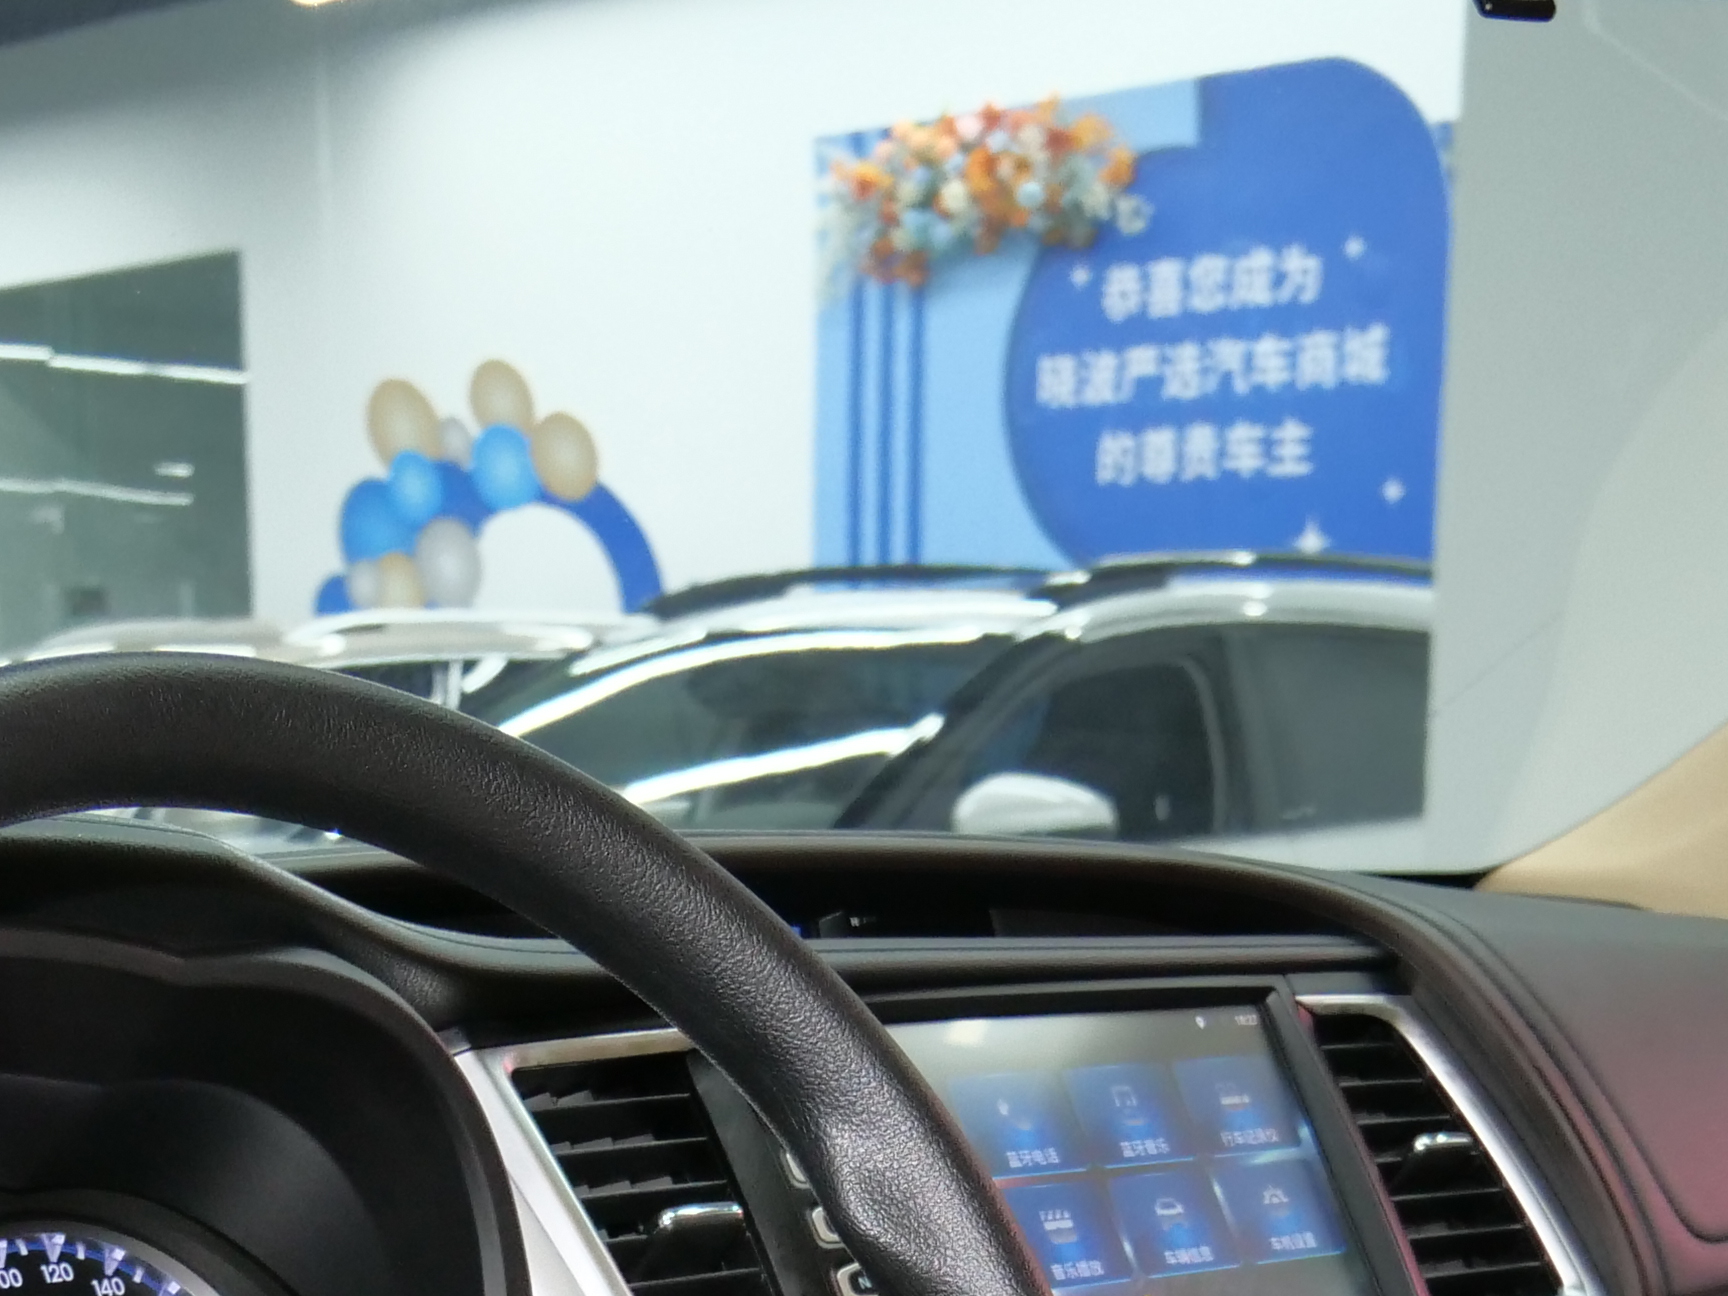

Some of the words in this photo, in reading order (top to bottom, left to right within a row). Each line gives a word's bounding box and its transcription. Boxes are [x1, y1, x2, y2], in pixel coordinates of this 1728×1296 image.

[1102, 243, 1324, 323] 恭喜您成为
[1096, 417, 1315, 486] 的尊贵车主
[40, 1262, 75, 1284] 120
